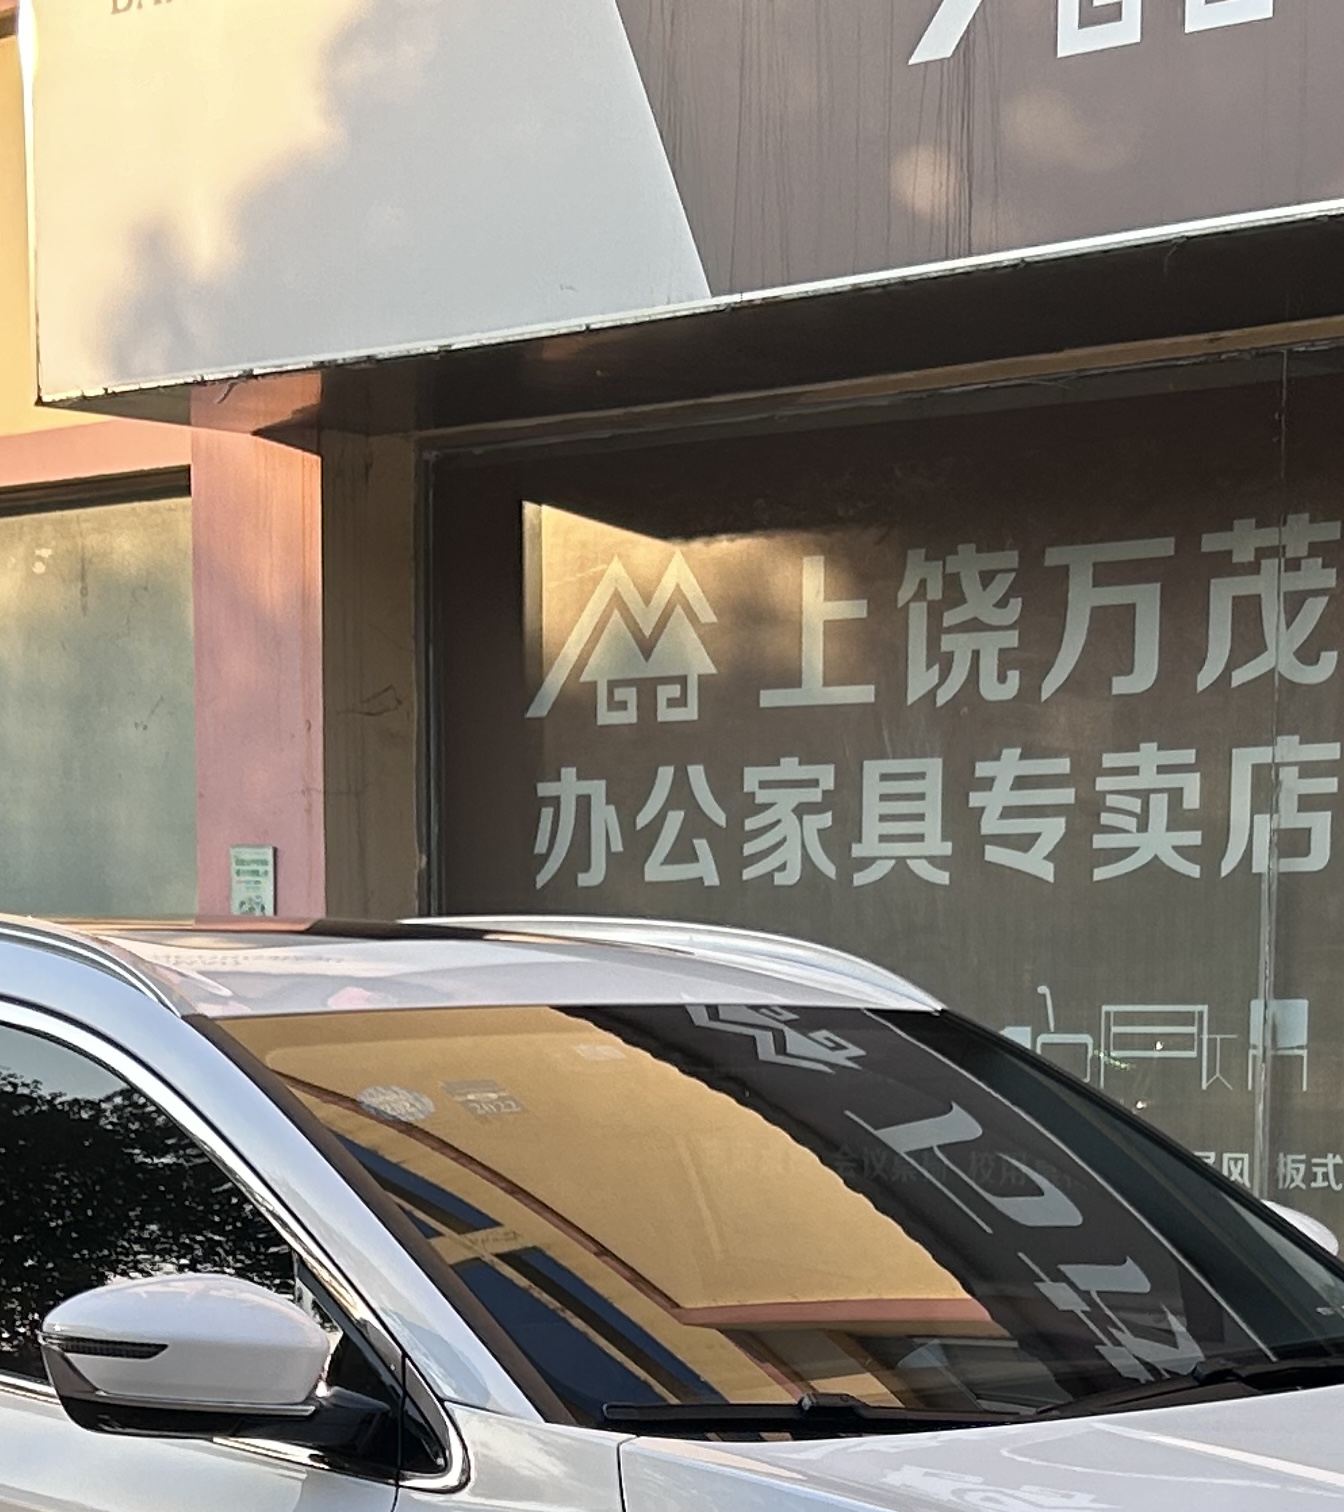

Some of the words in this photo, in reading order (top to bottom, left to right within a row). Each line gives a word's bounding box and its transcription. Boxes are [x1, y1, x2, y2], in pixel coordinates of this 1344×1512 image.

[759, 512, 1342, 708] 上饶万茂
[533, 735, 1342, 889] 办公家具专卖店
